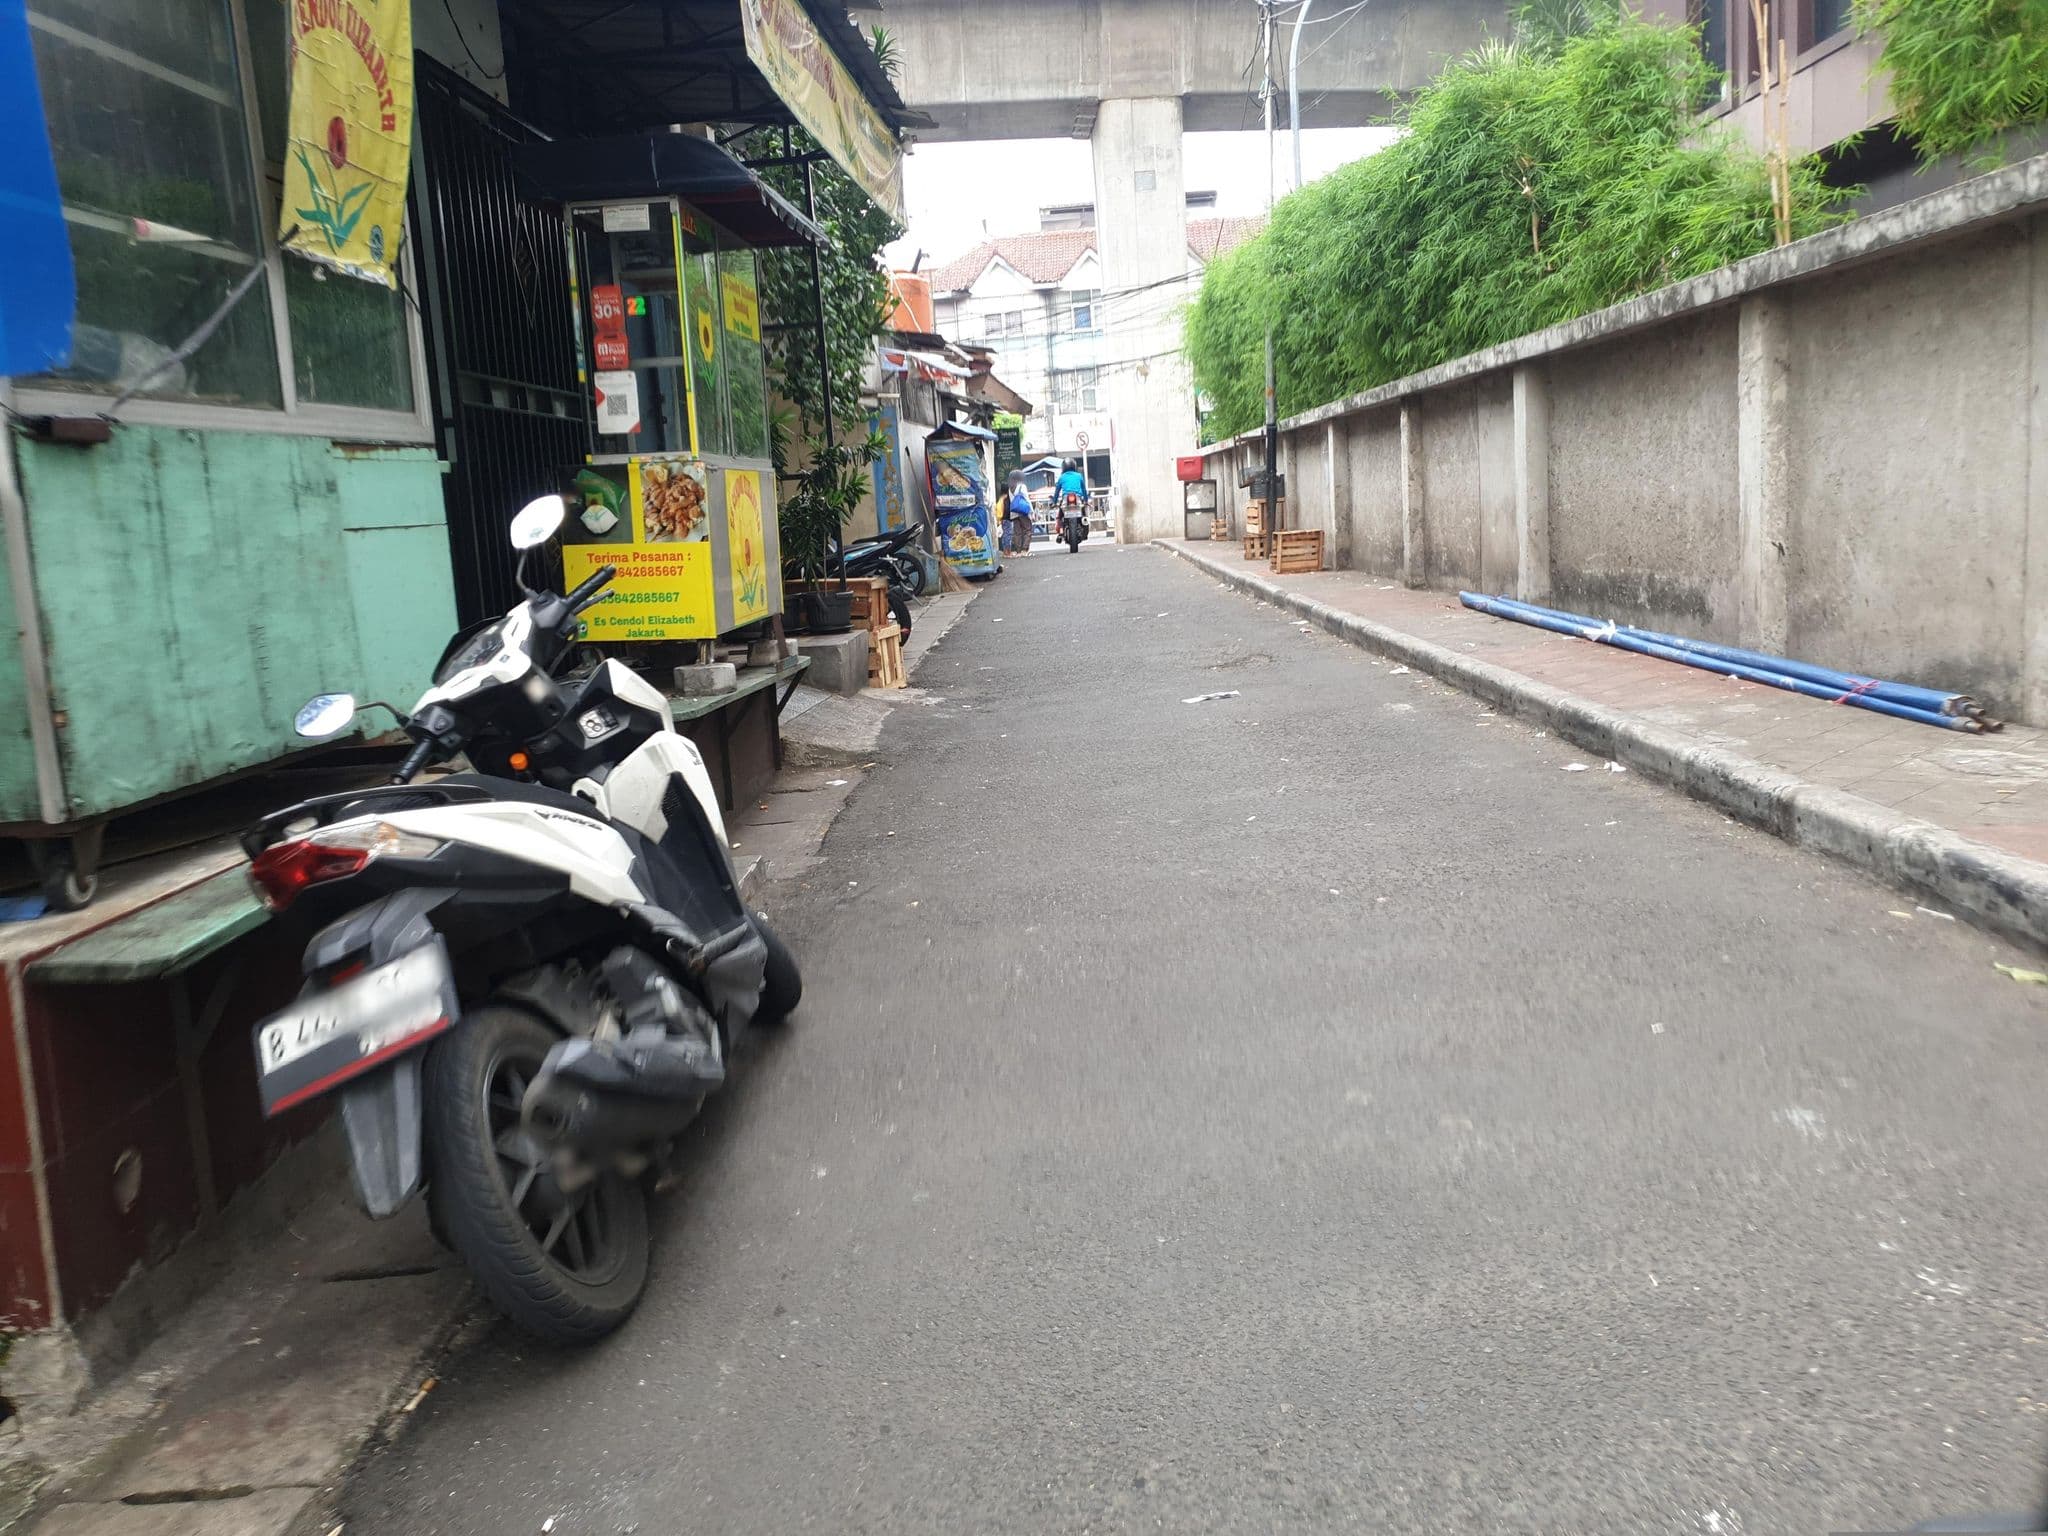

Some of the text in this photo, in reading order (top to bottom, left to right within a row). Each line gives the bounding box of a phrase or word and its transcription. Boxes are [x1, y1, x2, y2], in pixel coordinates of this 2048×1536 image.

[587, 552, 628, 563] Terima
[632, 551, 684, 561] Pesanan
[594, 614, 695, 626] Es Cendol Elizabeth
[625, 628, 665, 637] Jakarta
